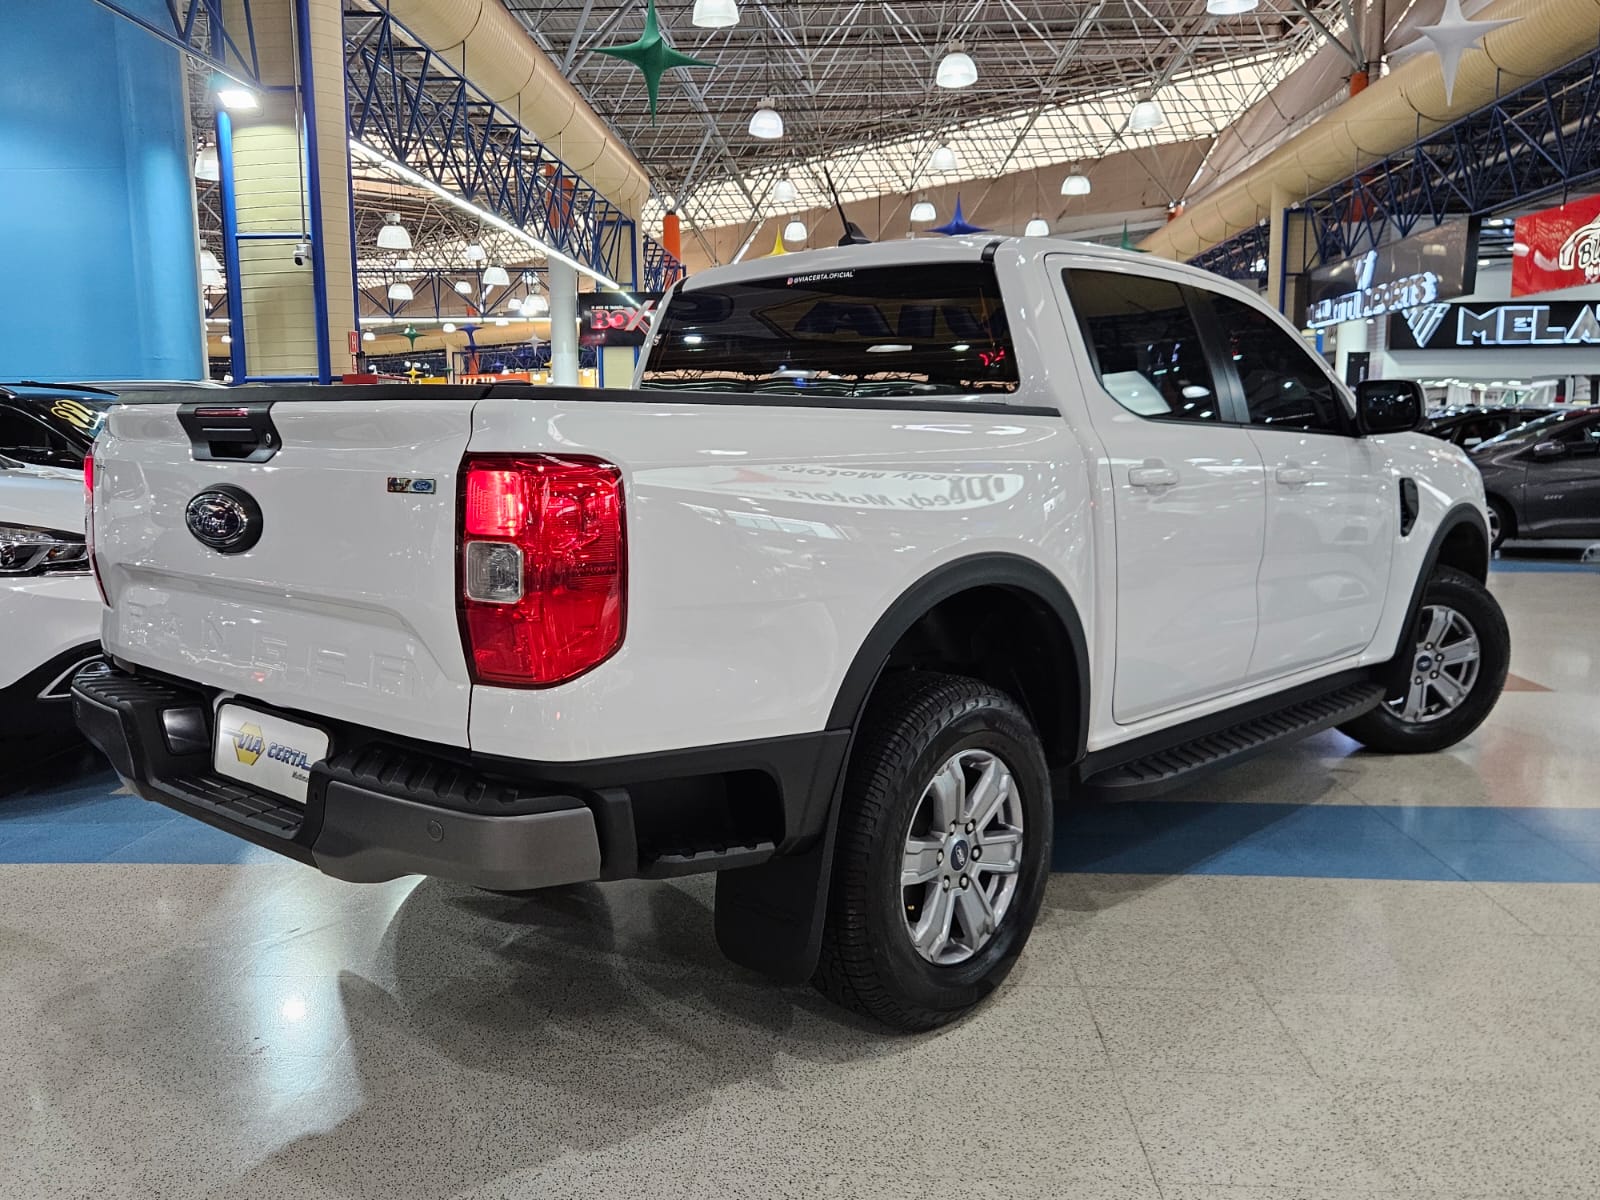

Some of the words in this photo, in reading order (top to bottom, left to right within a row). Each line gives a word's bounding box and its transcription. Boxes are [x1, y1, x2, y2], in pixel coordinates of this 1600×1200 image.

[591, 299, 656, 335] BOX
[1456, 304, 1600, 345] MELA
[237, 734, 263, 754] VIA
[267, 741, 310, 769] CERTA
